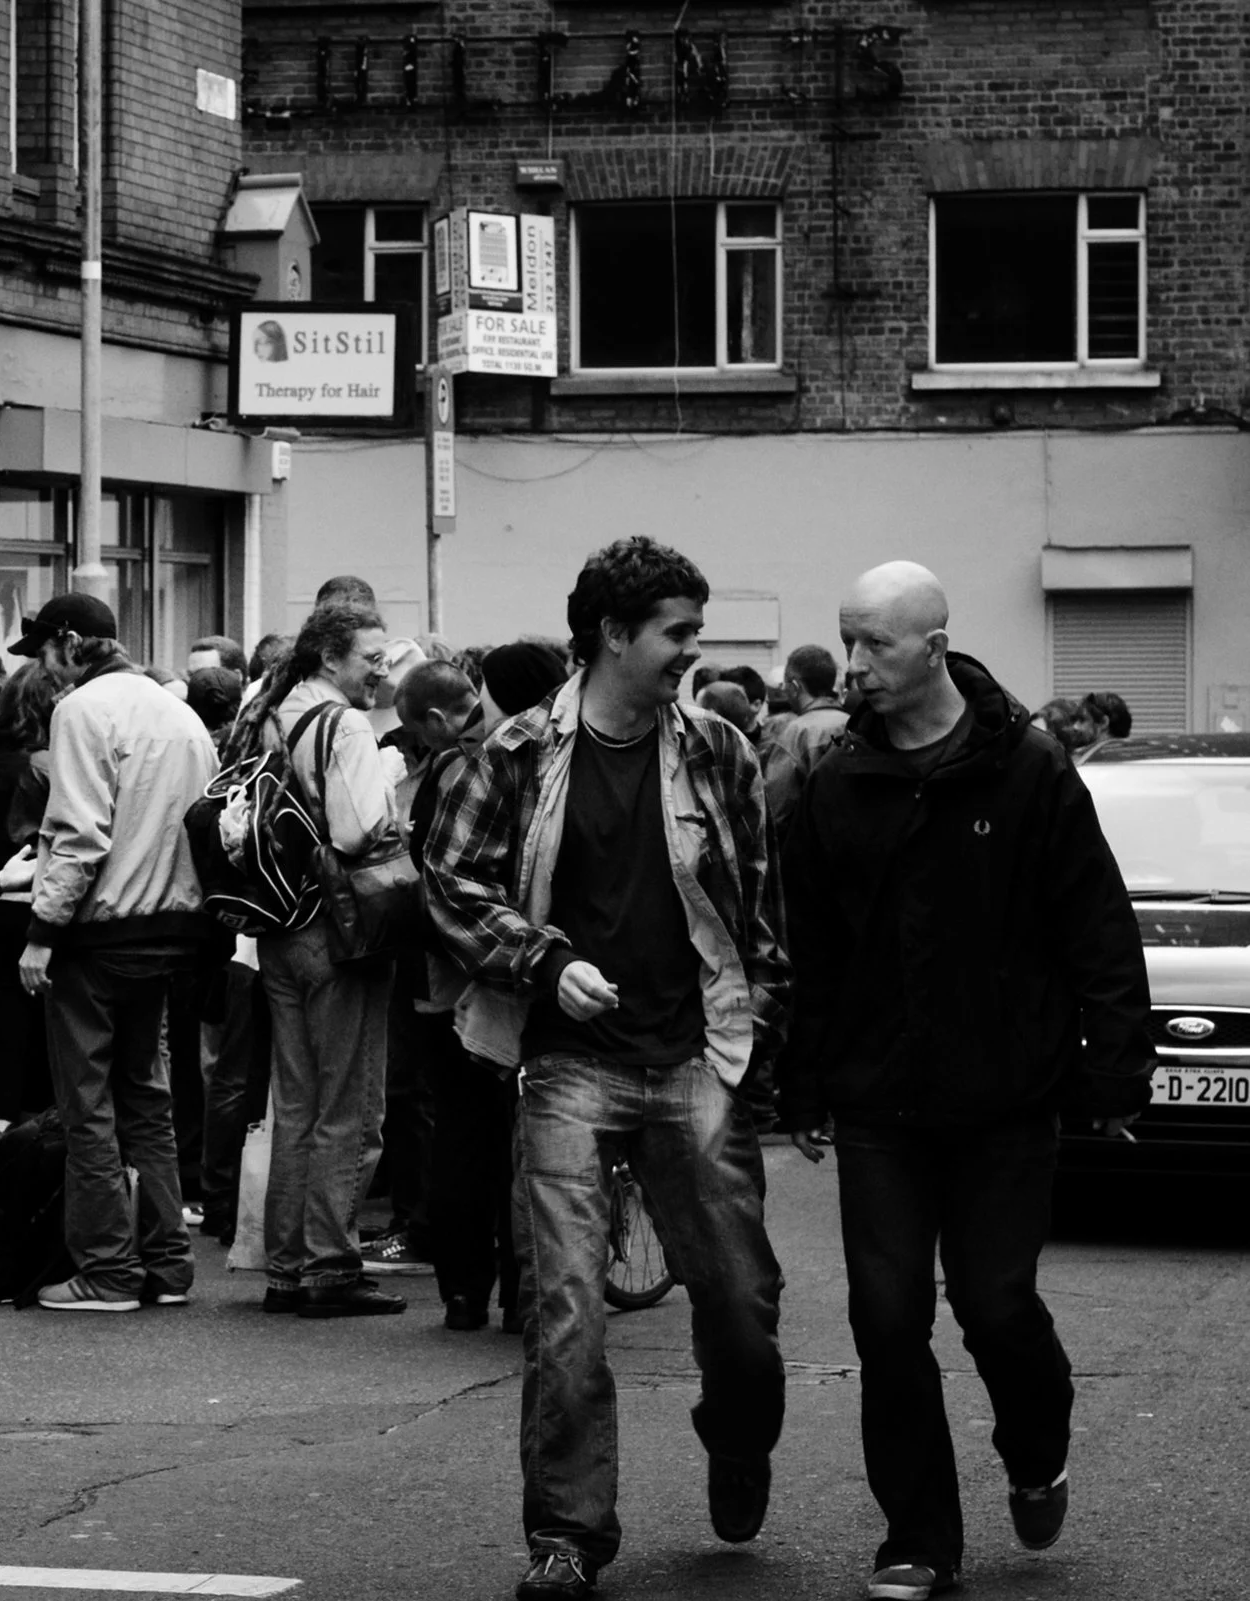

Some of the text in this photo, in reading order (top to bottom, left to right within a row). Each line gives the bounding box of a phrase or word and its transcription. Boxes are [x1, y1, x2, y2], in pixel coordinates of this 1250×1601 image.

[476, 316, 546, 335] FOR SALE
[293, 331, 386, 354] SitStil
[255, 383, 381, 401] Therapy for Hair
[1150, 1076, 1249, 1103] -D-2210
